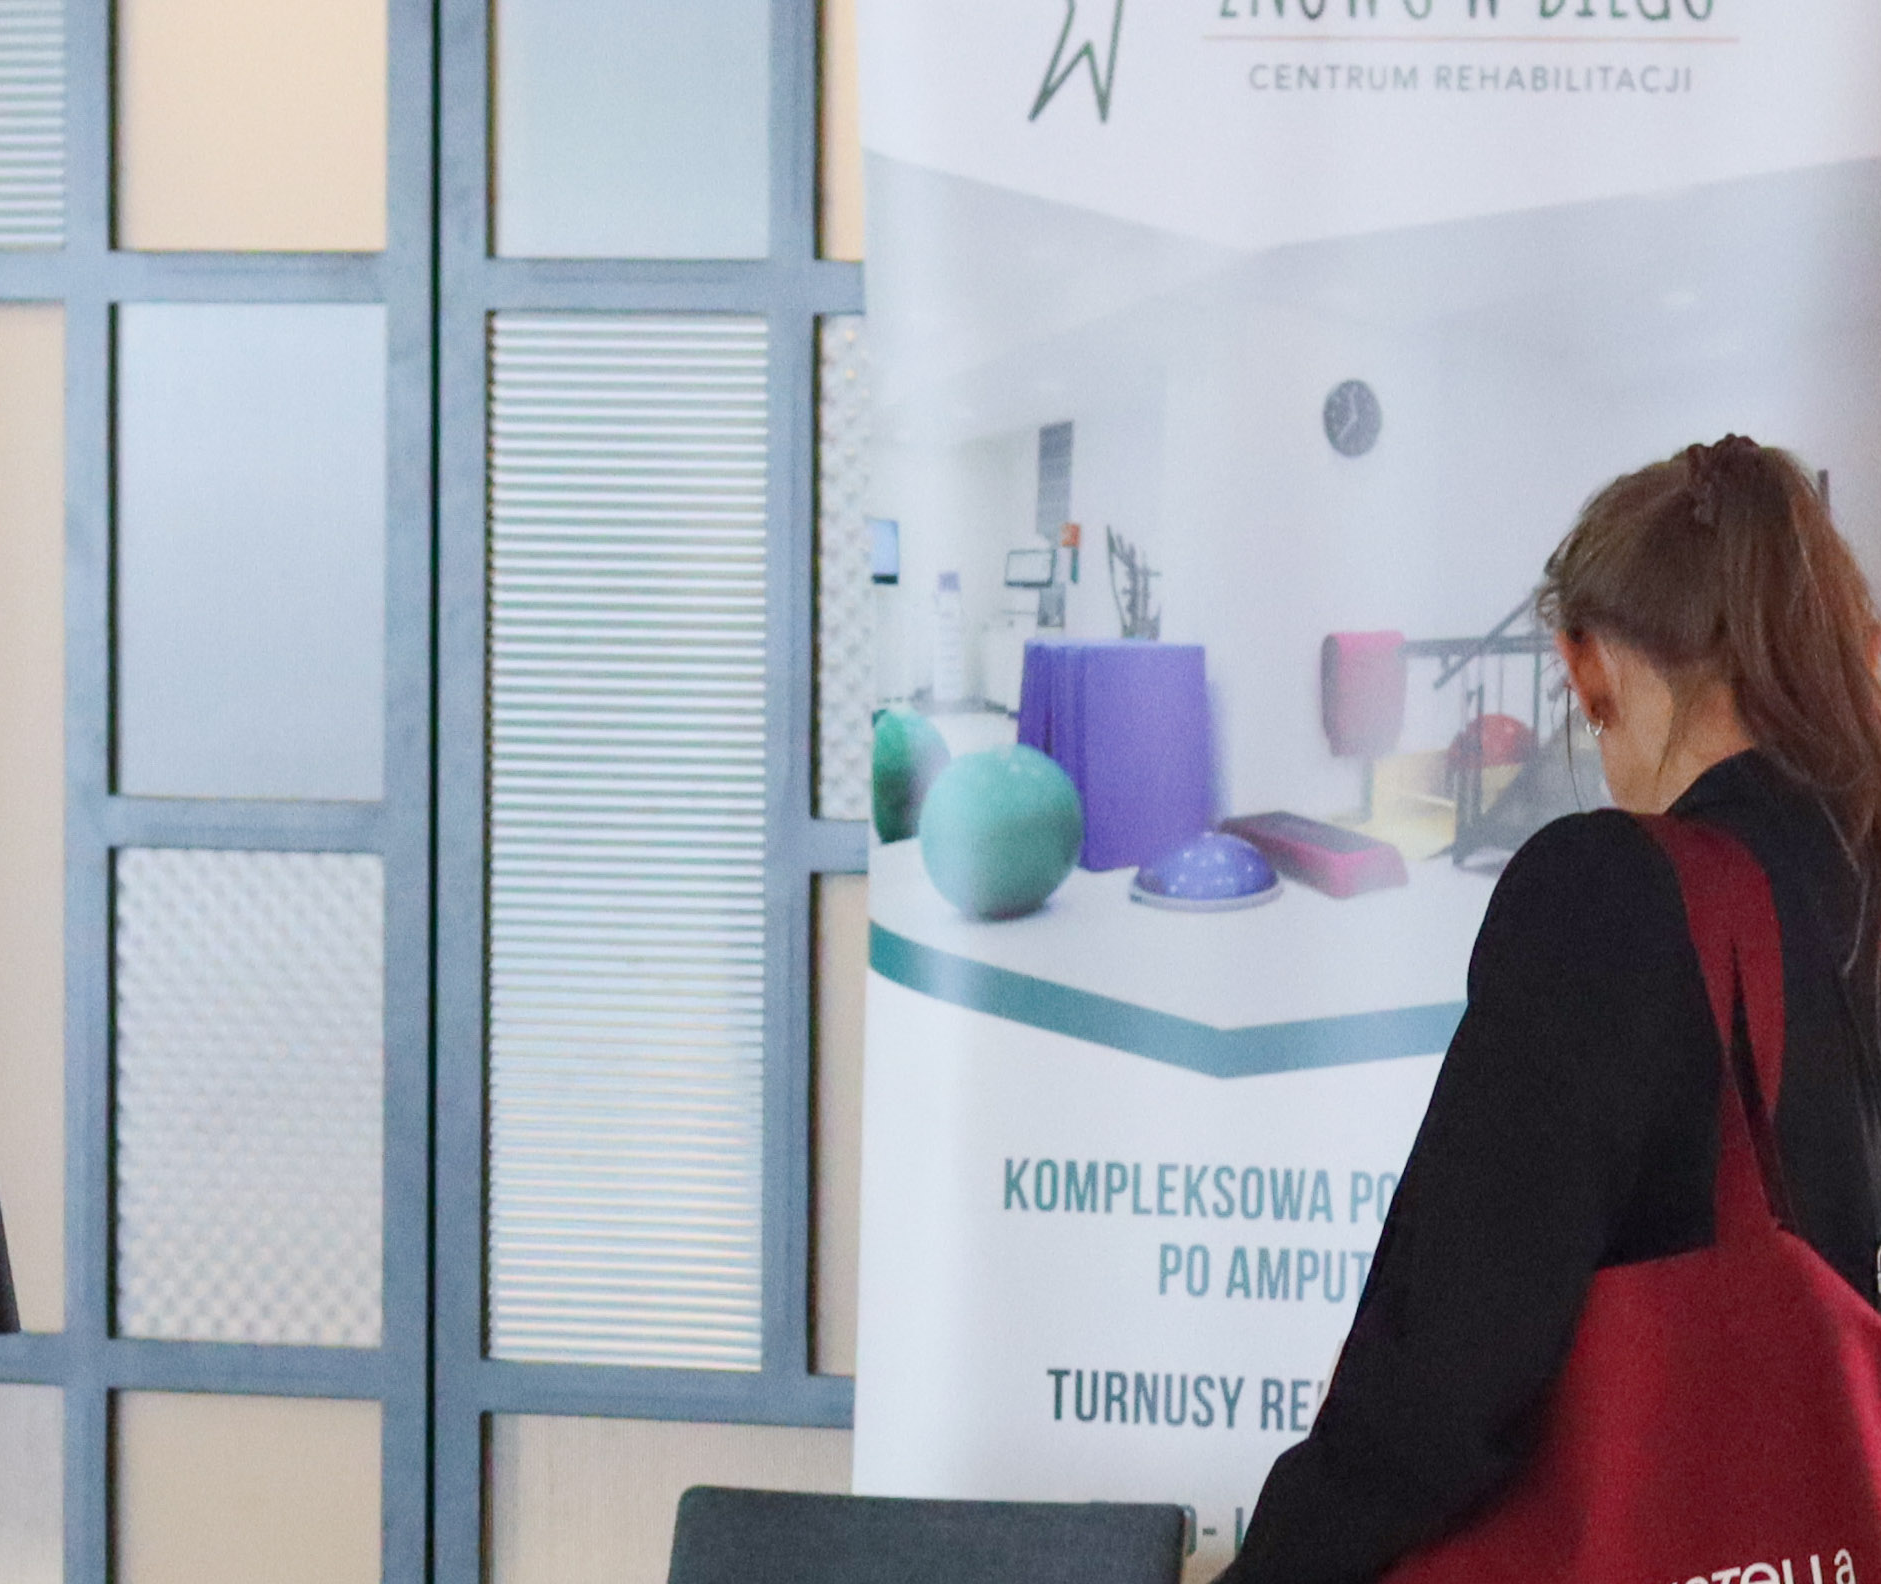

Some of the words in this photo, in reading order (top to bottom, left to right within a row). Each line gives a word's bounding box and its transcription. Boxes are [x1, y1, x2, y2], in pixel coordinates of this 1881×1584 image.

[1248, 63, 1419, 92] CENTRUM
[1434, 64, 1694, 94] REHABILITACJI
[1004, 1158, 1334, 1223] KOMPLEKSOWA
[1158, 1243, 1211, 1297] PO
[1225, 1246, 1376, 1303] AMPUT
[1047, 1368, 1245, 1430] TURNUSY
